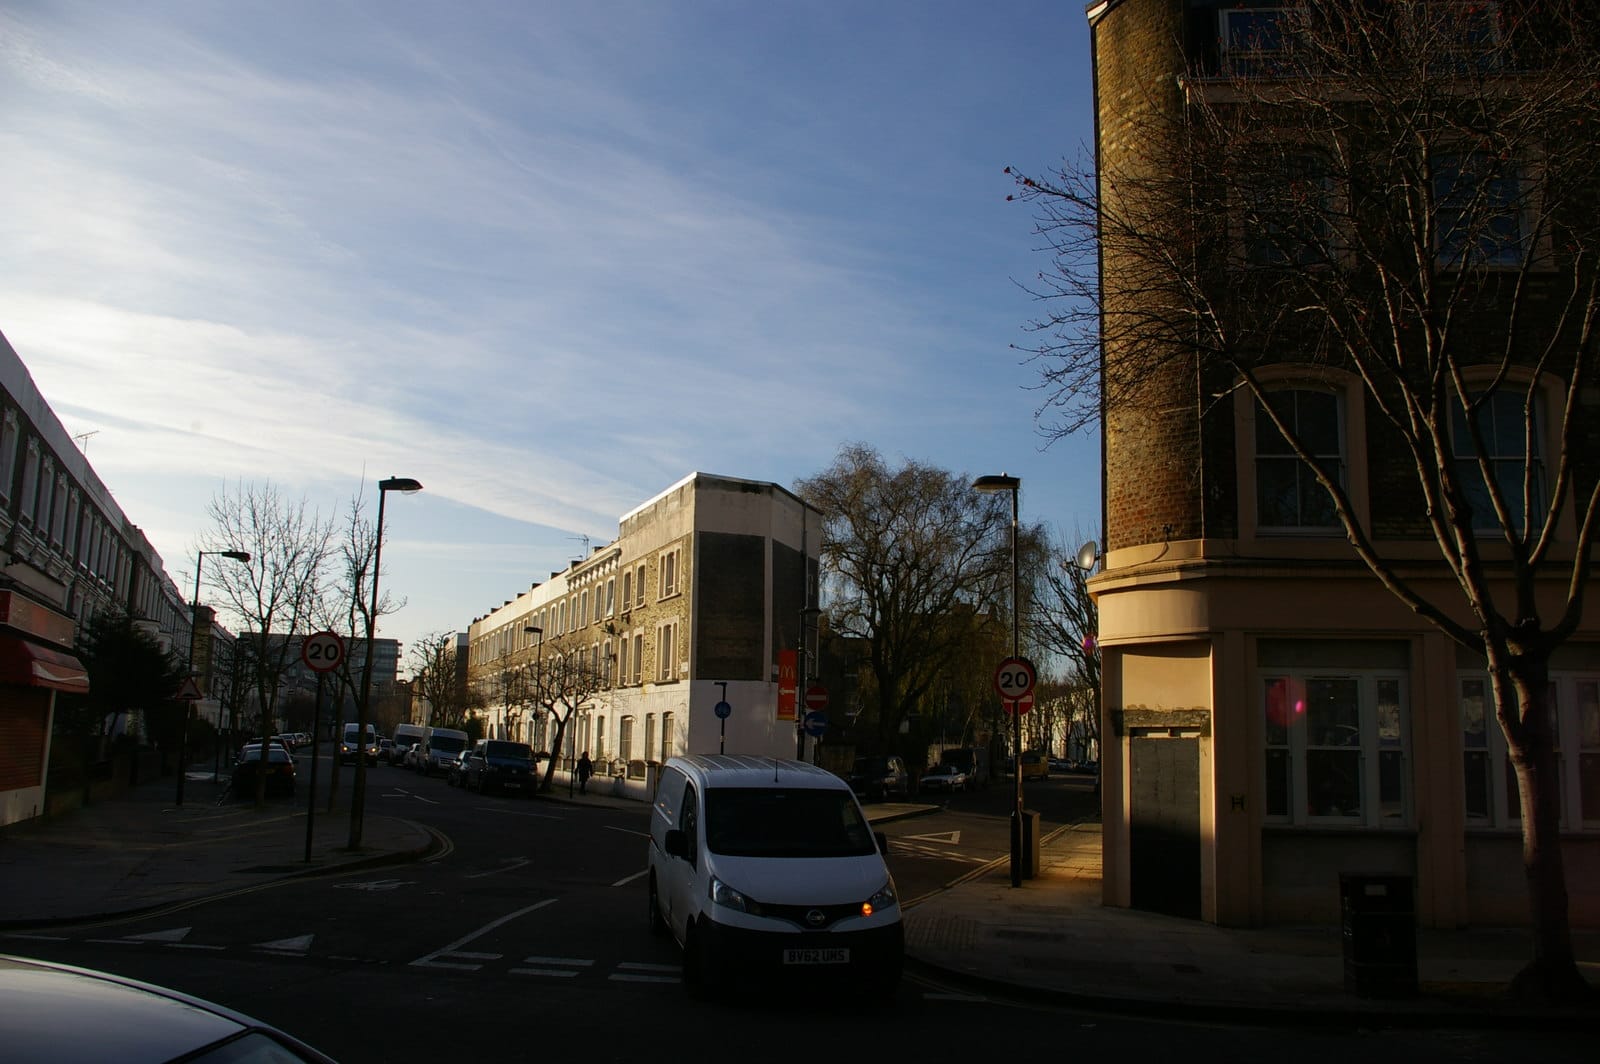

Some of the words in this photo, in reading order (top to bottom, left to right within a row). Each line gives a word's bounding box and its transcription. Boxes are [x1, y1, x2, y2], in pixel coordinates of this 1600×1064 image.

[309, 643, 339, 660] 20
[1001, 671, 1029, 688] 20
[788, 950, 819, 961] BV62
